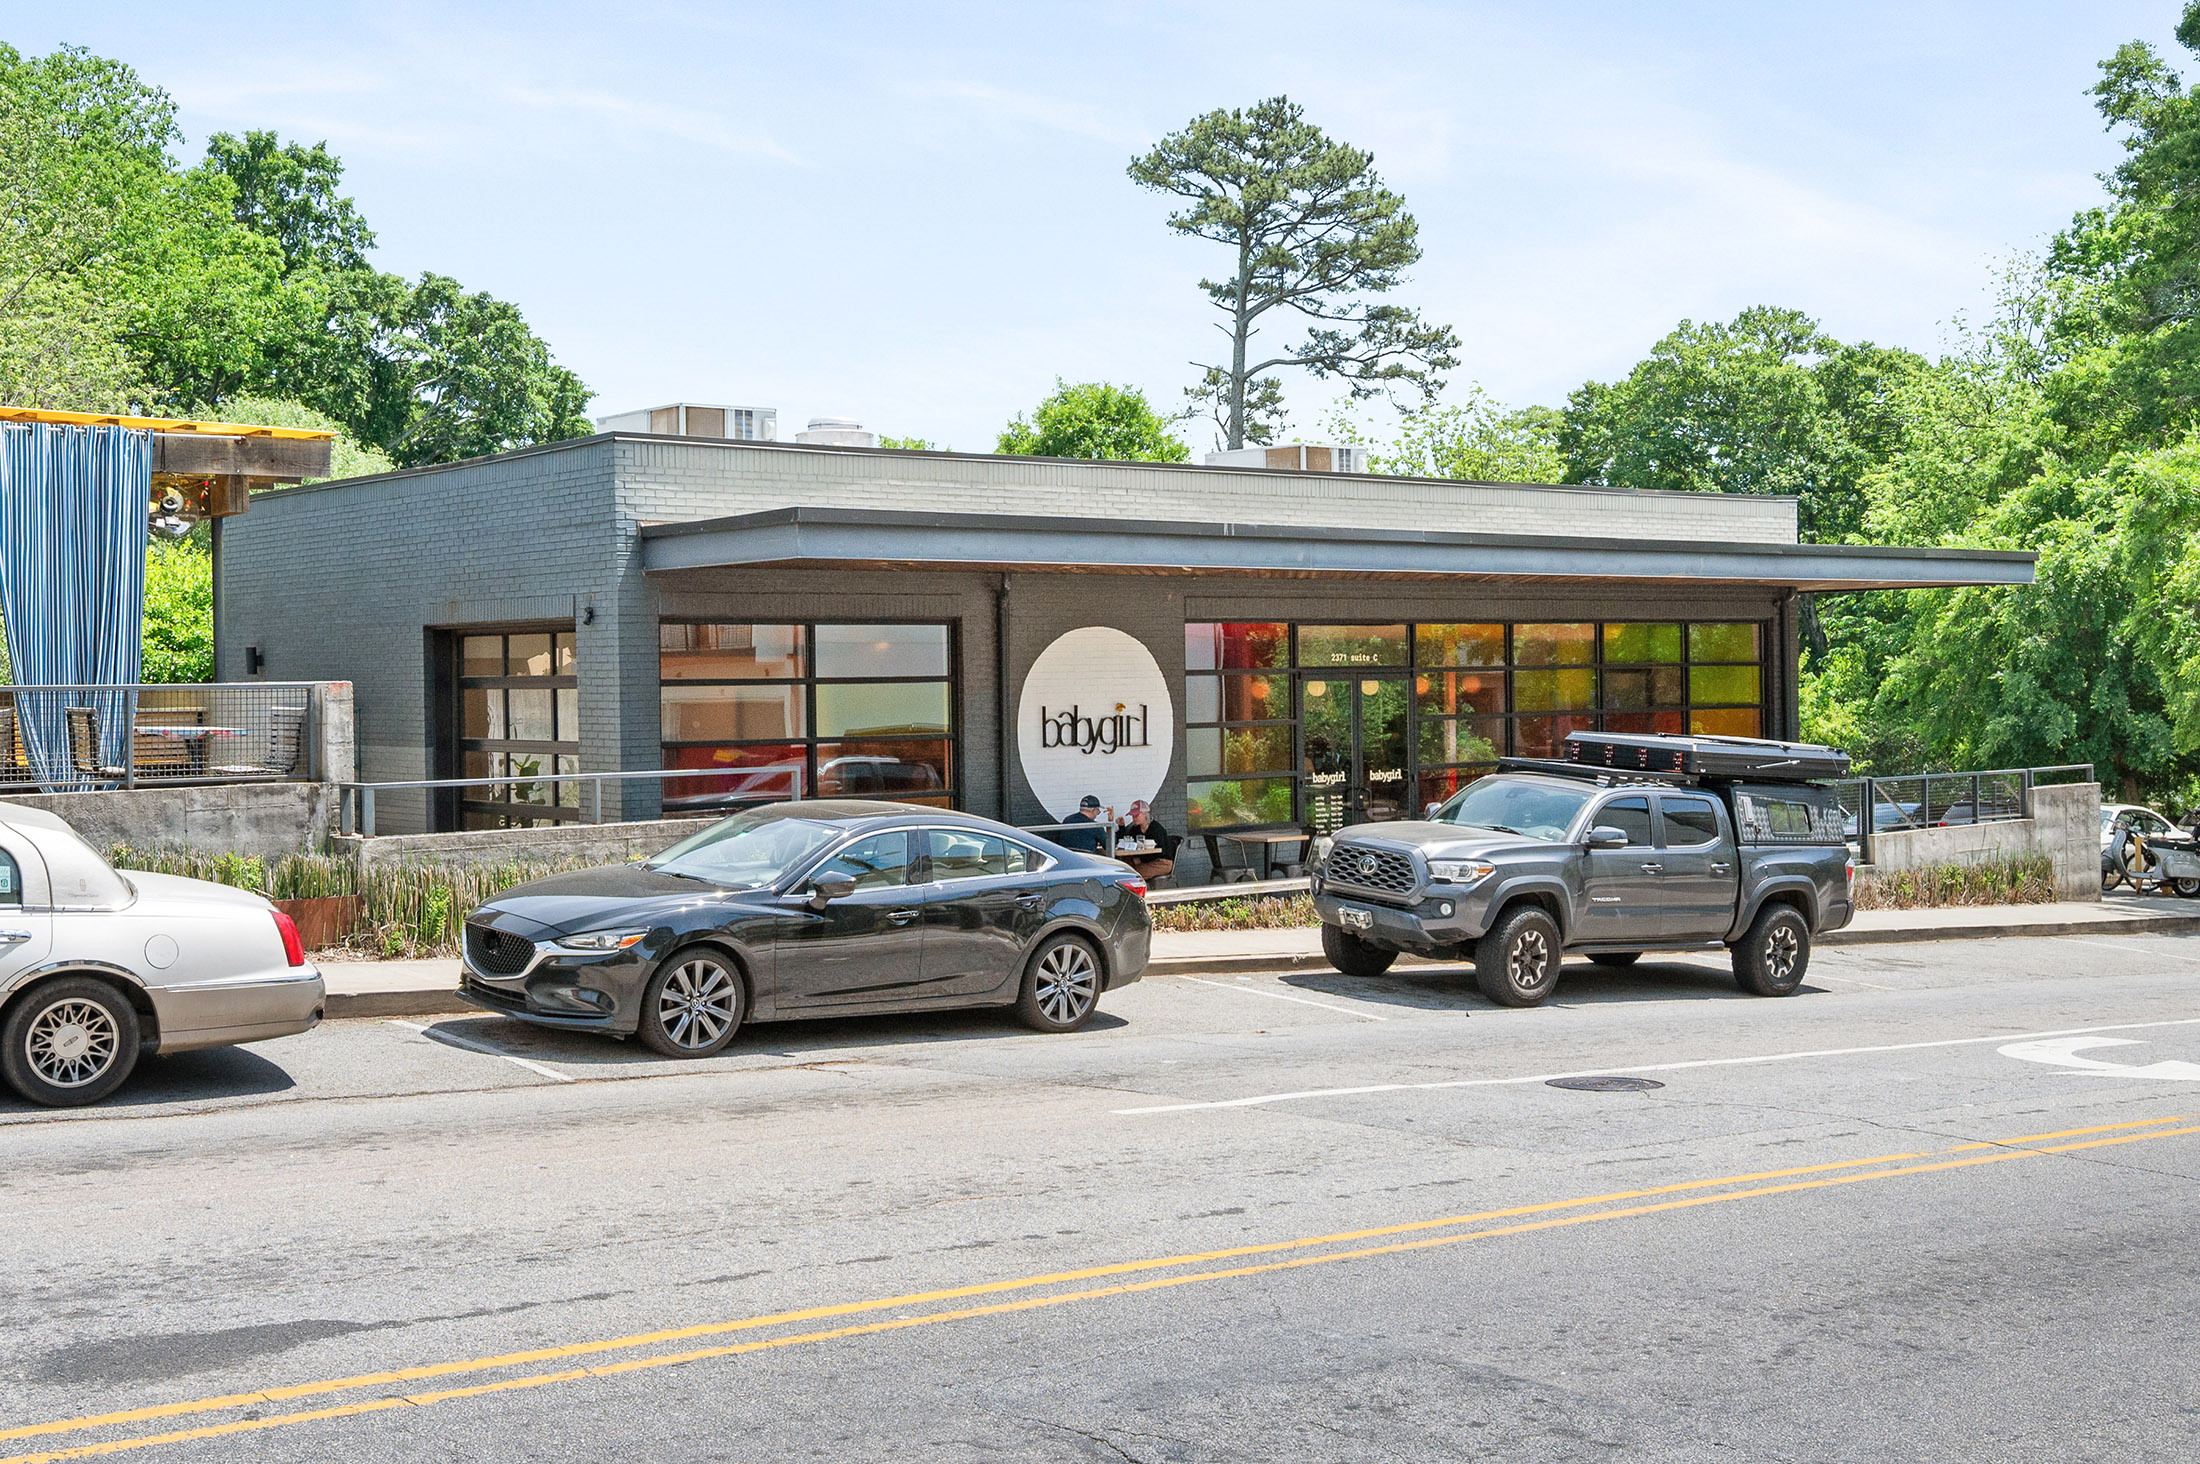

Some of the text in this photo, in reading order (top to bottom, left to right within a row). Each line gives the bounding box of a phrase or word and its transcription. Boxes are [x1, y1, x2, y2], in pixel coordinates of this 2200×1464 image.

[1331, 653, 1379, 662] 2371 suite C
[1041, 702, 1151, 755] babygirl
[1312, 770, 1346, 785] babygirl
[1369, 768, 1402, 783] babygirl
